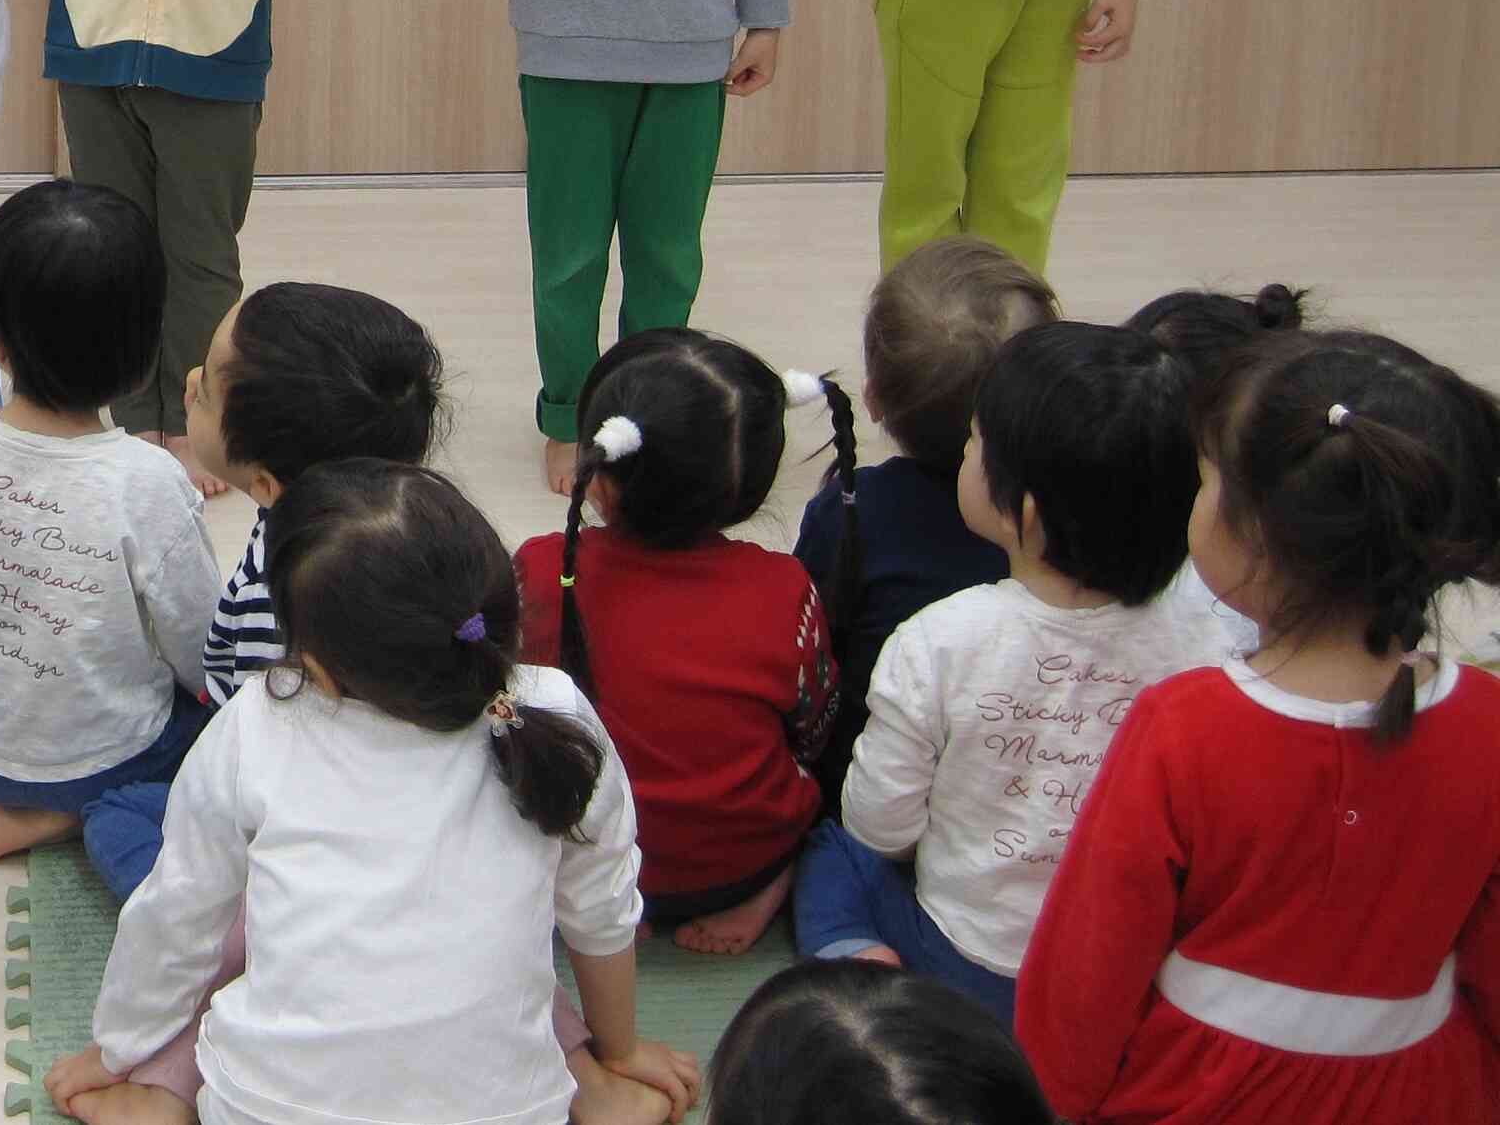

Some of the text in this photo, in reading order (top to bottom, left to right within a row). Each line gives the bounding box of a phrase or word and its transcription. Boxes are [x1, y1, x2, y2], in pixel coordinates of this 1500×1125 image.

[32, 526, 118, 562] Buns
[1036, 654, 1137, 685] Cakes
[975, 692, 1088, 735] Sticky
[984, 734, 1106, 764] Marma
[1003, 776, 1029, 799] &
